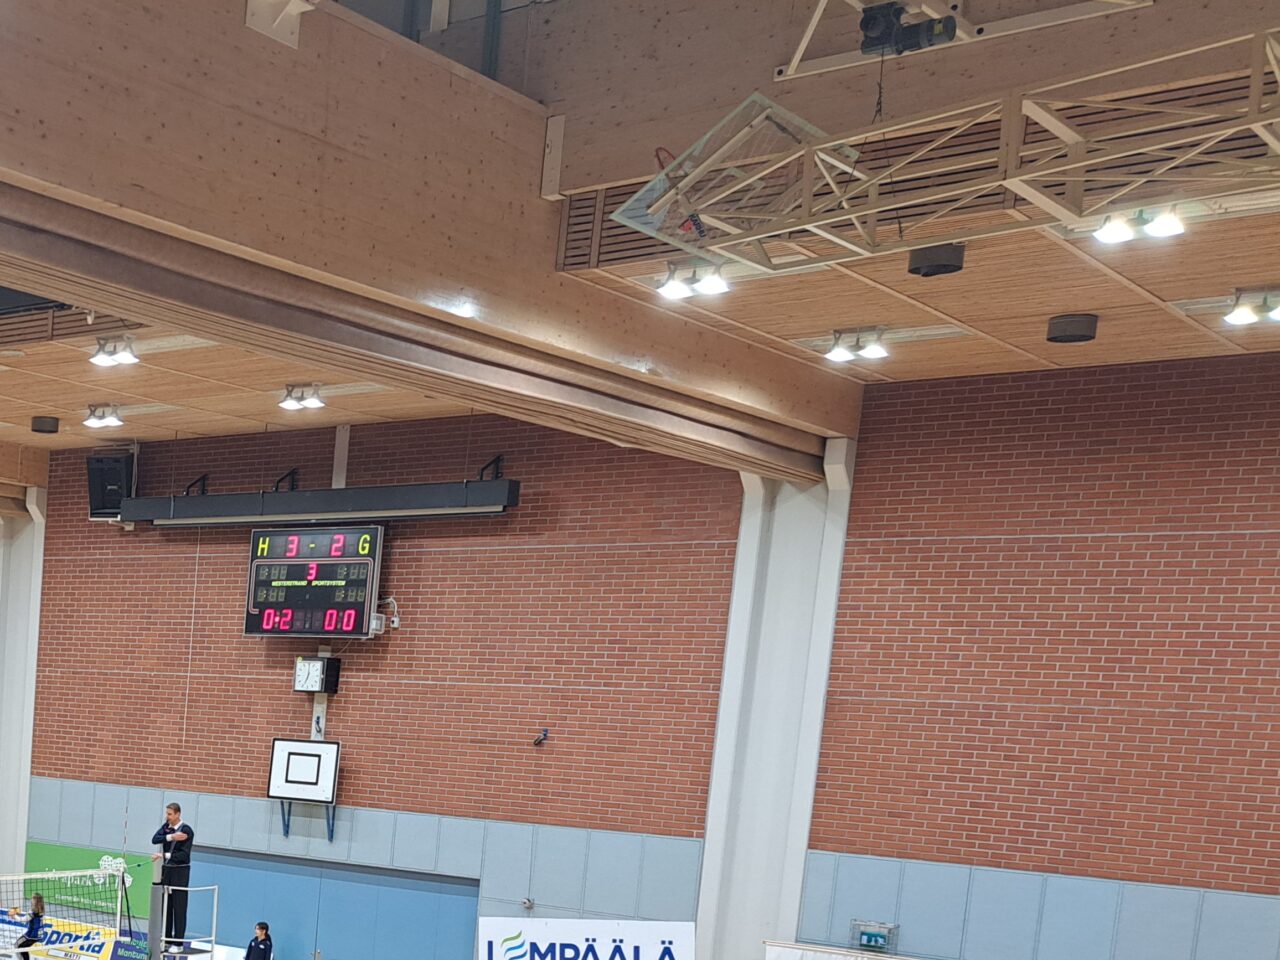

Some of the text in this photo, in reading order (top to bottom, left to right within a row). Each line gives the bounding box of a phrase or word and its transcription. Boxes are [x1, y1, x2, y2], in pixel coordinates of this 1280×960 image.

[257, 536, 270, 556] H
[286, 535, 299, 557] 3
[330, 534, 345, 556] 2
[358, 534, 371, 554] G
[307, 562, 318, 580] 3
